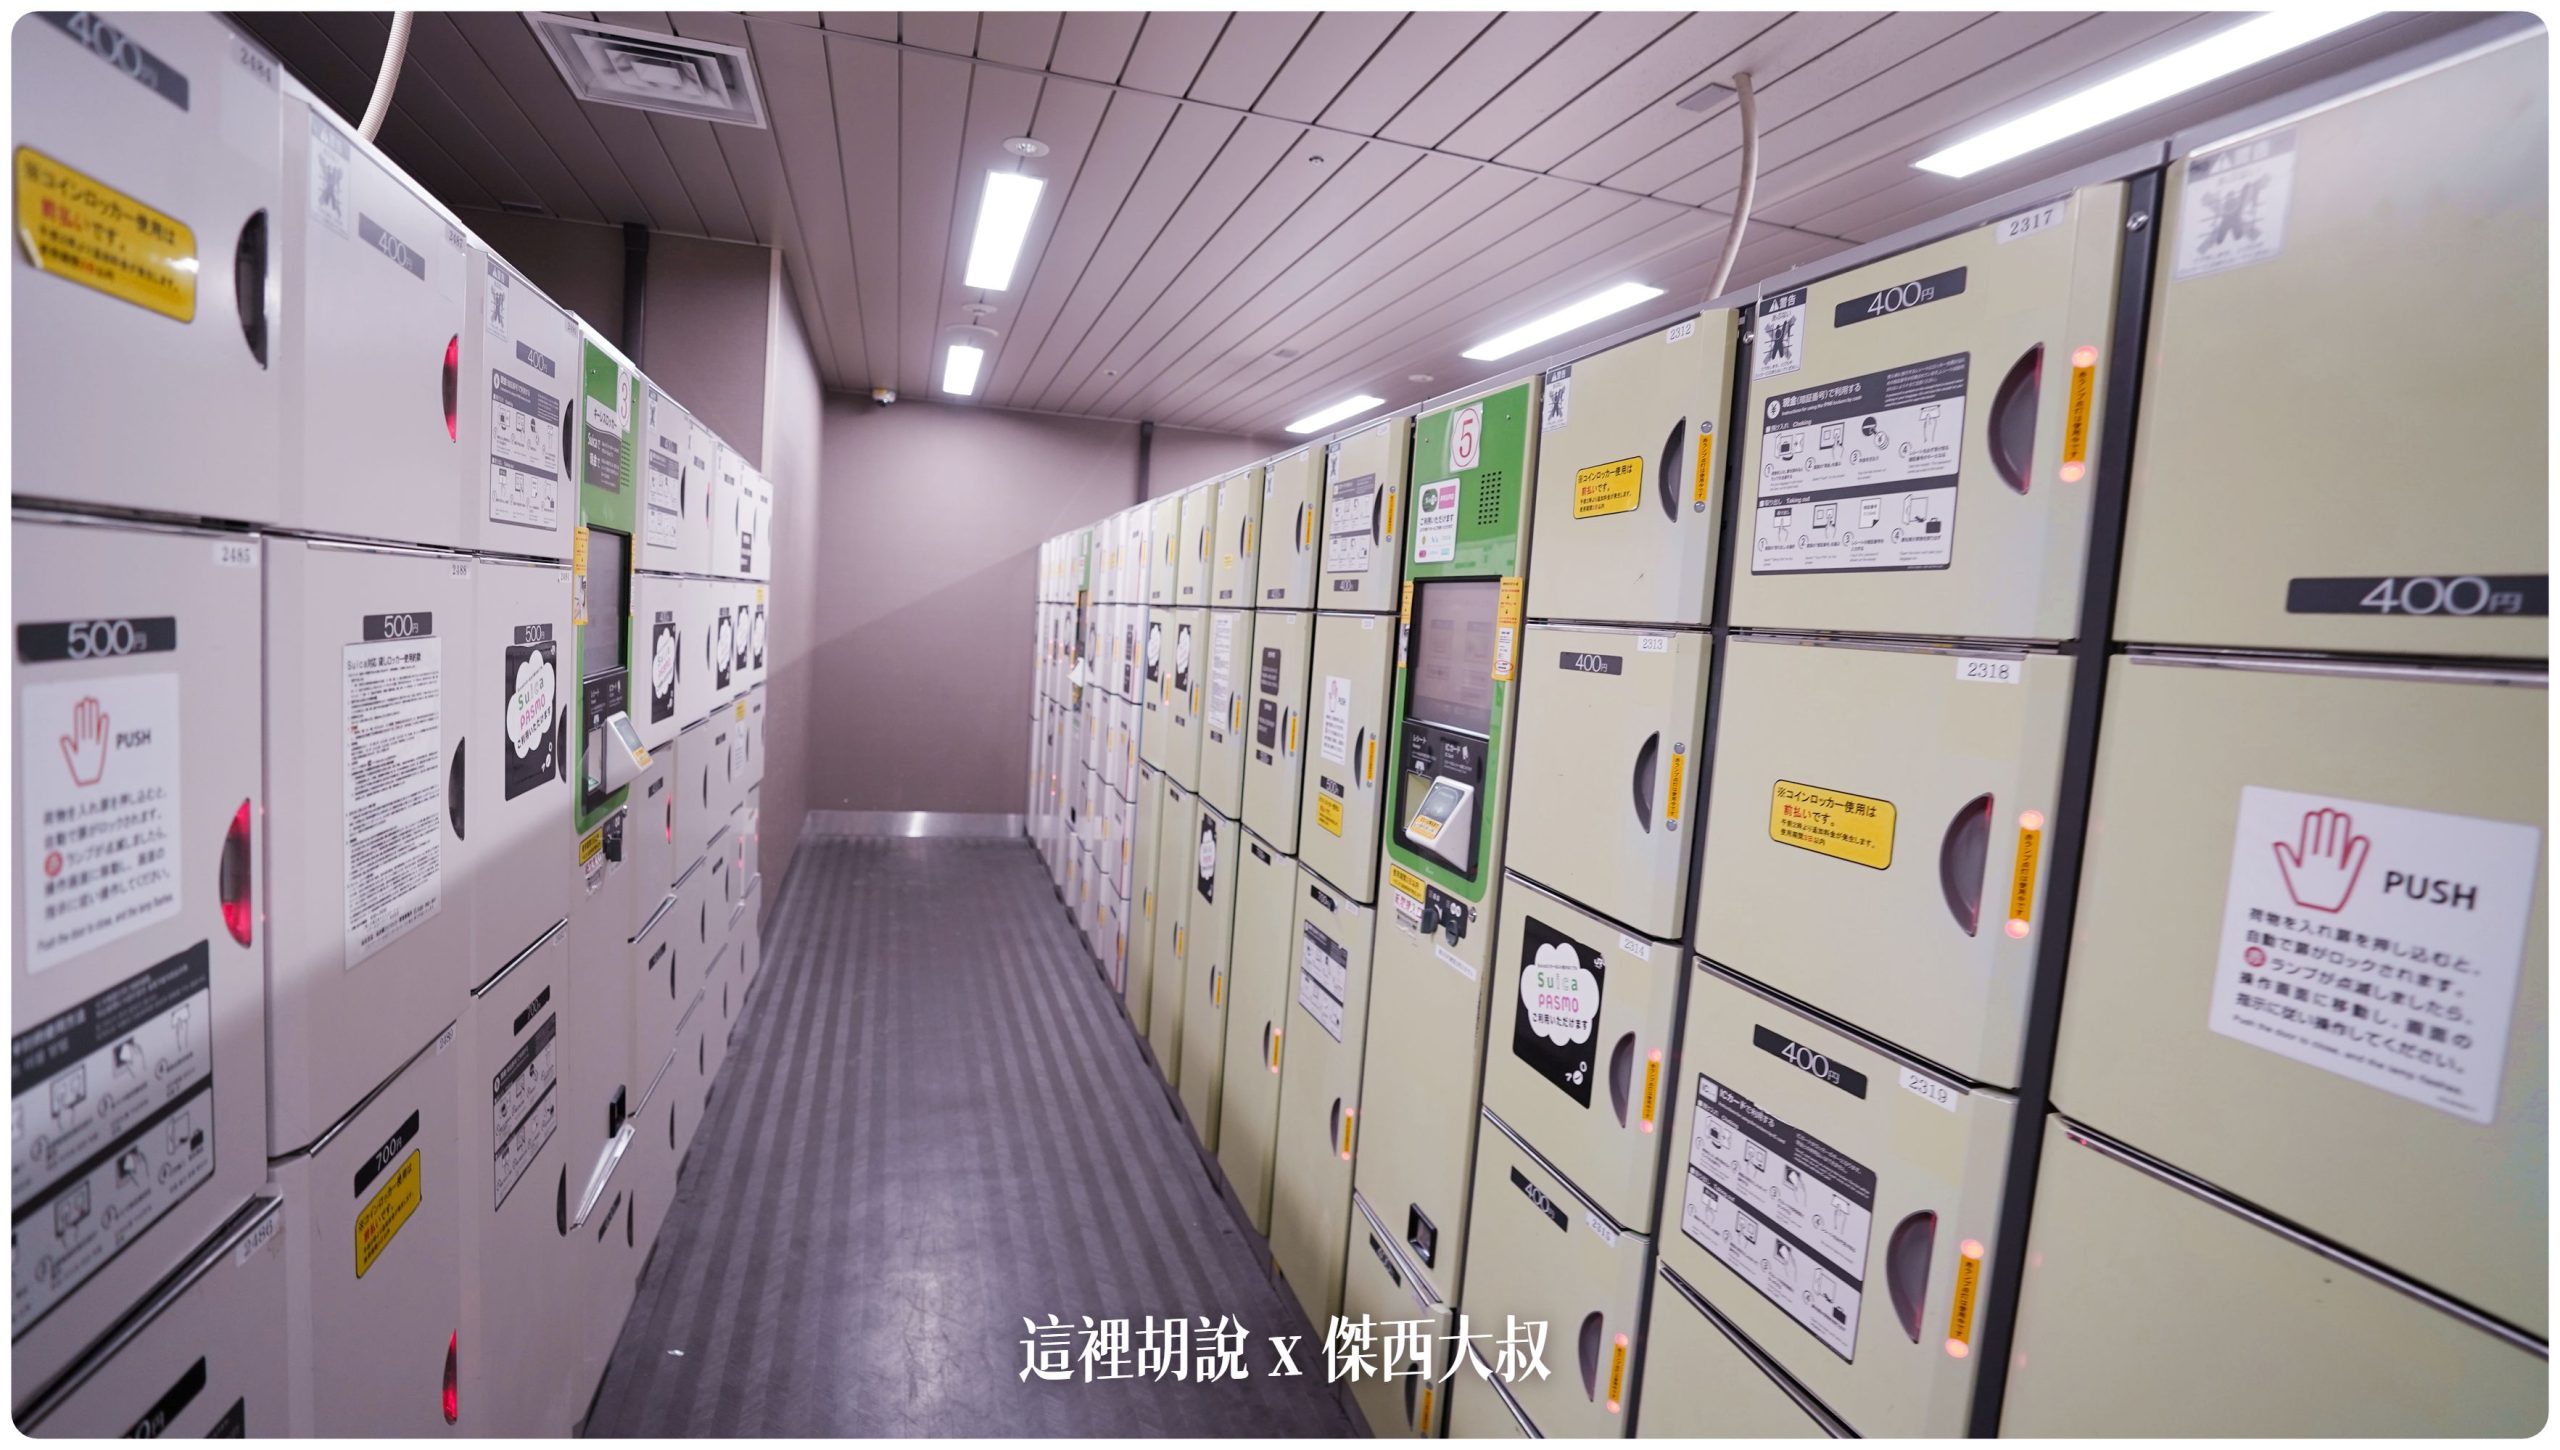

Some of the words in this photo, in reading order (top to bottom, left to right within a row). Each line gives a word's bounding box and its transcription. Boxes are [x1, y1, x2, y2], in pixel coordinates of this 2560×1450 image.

[2010, 209, 2053, 236] 2317
[379, 231, 413, 270] 400円
[1867, 281, 1934, 316] 400円
[1669, 323, 1692, 340] 2312
[621, 382, 628, 419] 3
[1459, 419, 1473, 458] 5
[2361, 575, 2524, 616] 400円
[67, 619, 148, 660] 500円
[384, 615, 418, 638] 500円
[525, 624, 545, 642] 500円
[1643, 638, 1663, 650] 2313
[1575, 655, 1608, 673] 400円
[1967, 662, 2010, 681] 2318
[520, 694, 546, 730] PASMO
[115, 728, 152, 750] PUSH
[1777, 787, 1878, 818] ※コインロッカー使用は
[1783, 804, 1835, 827] 前払いです。
[2384, 870, 2478, 911] PUSH
[1538, 993, 1579, 1014] PASMO
[1532, 1012, 1588, 1031] ご利用いただけます
[1781, 1042, 1840, 1085] 400円
[376, 1136, 402, 1171] 700円
[1525, 1183, 1556, 1220] 400円
